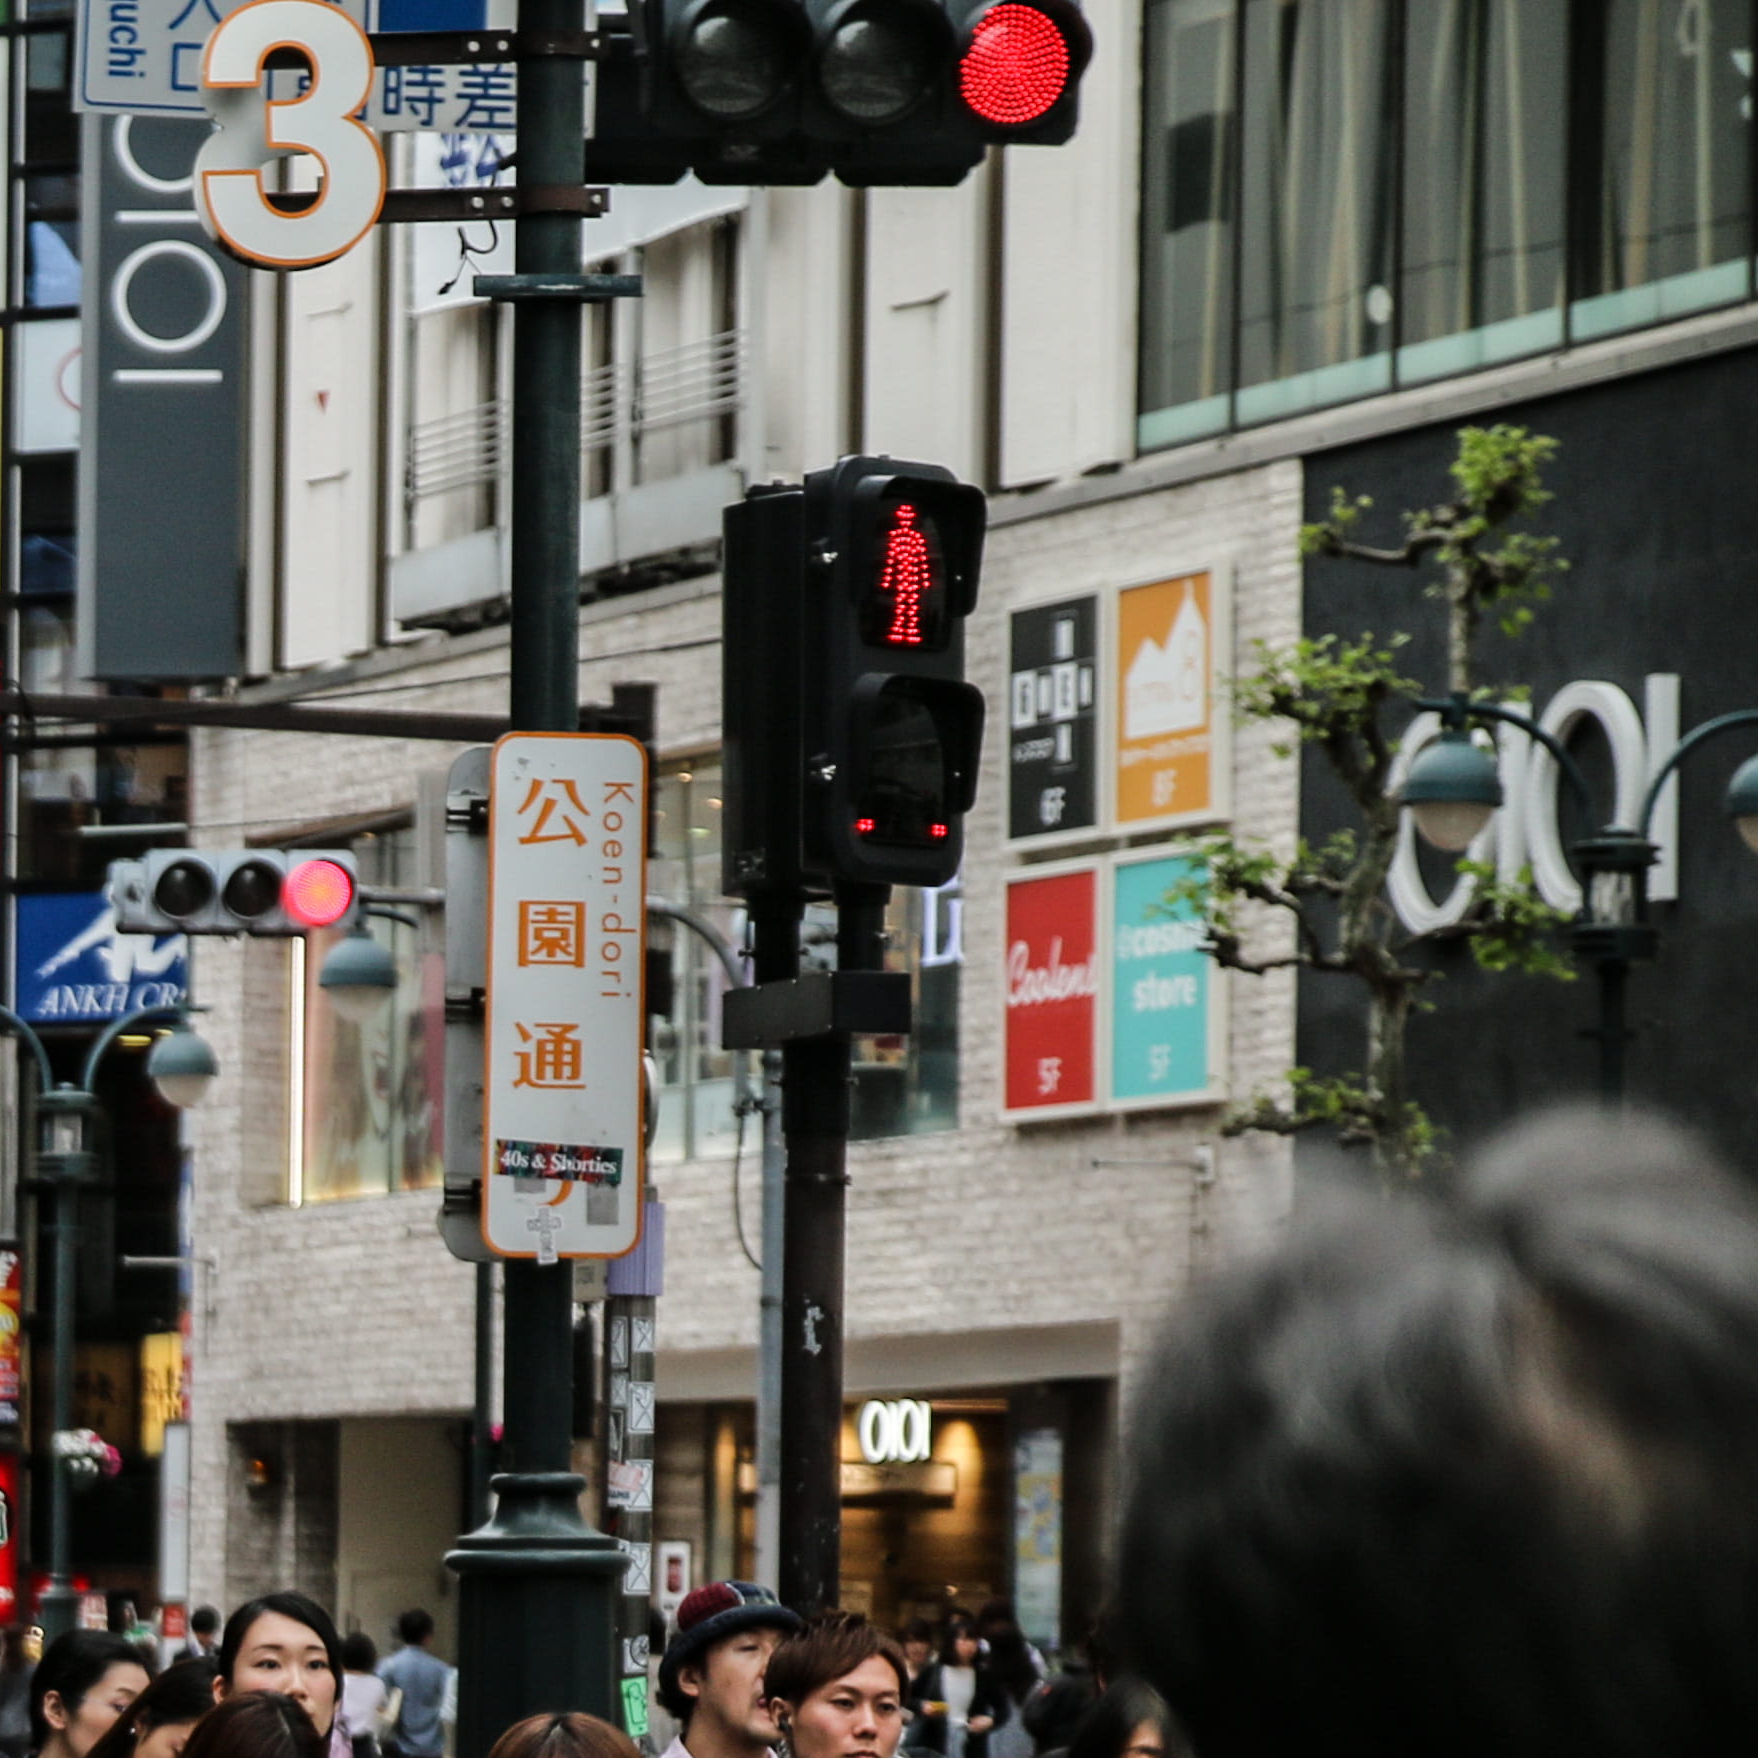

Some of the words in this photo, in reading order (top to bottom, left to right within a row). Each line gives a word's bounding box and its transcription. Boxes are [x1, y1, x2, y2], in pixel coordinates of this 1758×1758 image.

[197, 0, 386, 270] 3
[600, 781, 637, 999] Koen-dori
[35, 982, 129, 1015] ANKH
[134, 981, 186, 1010] CR
[1134, 971, 1197, 1012] store
[531, 1153, 548, 1169] &
